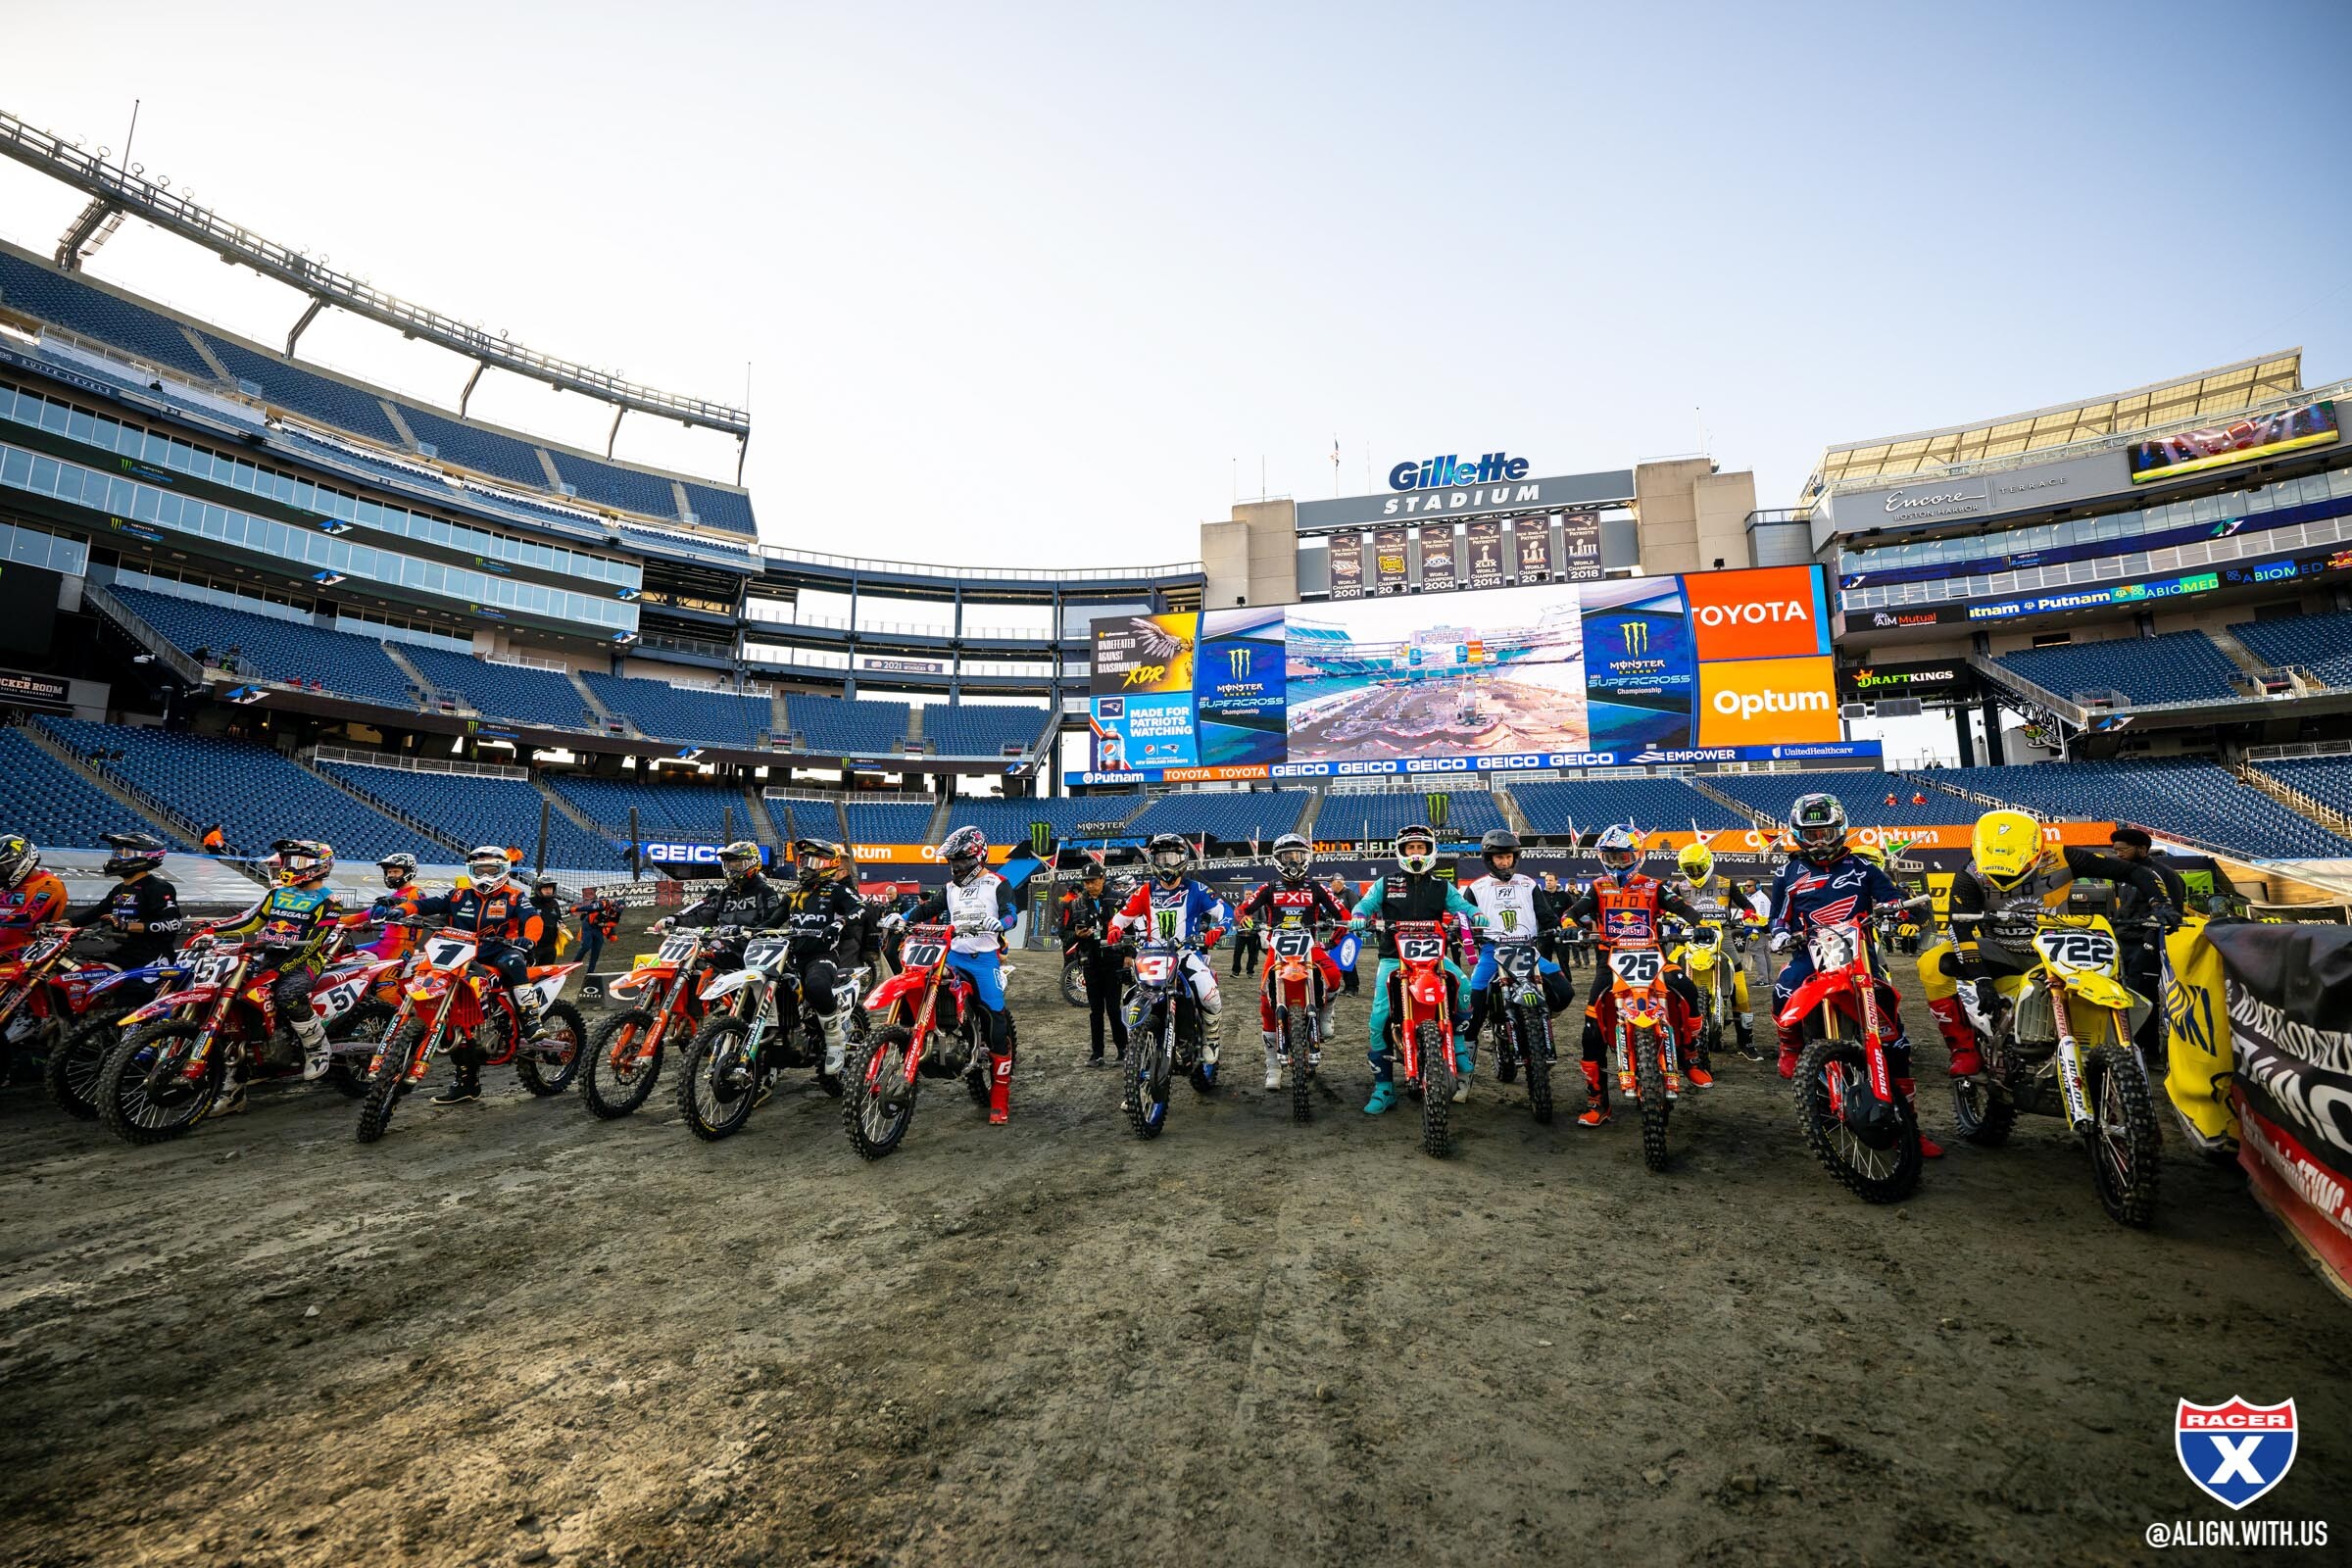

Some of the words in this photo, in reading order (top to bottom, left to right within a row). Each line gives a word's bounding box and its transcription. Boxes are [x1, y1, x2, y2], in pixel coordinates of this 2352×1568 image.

[22, 360, 59, 376] SUITE
[66, 374, 111, 395] LEVELS
[1388, 452, 1530, 491] Gillette
[1383, 485, 1540, 514] STADIUM
[1885, 490, 1986, 513] Encore
[1999, 477, 2067, 494] TERRACE
[1894, 511, 1935, 521] BOSTON
[1936, 504, 1979, 515] HARBOR
[1570, 570, 1599, 579] 2018
[1425, 581, 1454, 590] 2004
[1473, 578, 1500, 587] 2014
[2145, 578, 2220, 599] ABIOMED
[1334, 589, 1360, 598] 2001
[2037, 592, 2111, 611] Putnam
[1690, 601, 1808, 626] TOYOTA
[1876, 616, 1897, 626] AIM
[1898, 612, 1936, 624] Mutual
[1098, 638, 1136, 651] UNDEFEATED
[1098, 651, 1124, 662] AGAINST
[1098, 662, 1142, 674] RANSOMWARE
[1609, 660, 1666, 670] MONSTER
[1121, 665, 1166, 691] XDR
[1588, 674, 1691, 688] SUPERCROSS
[1858, 670, 1954, 688] DRAFTKINGS
[32, 682, 64, 694] ROOM
[1216, 683, 1264, 693] MONSTER
[1617, 686, 1662, 695] Championship
[1199, 697, 1285, 709] SUPERCROSS
[1713, 689, 1830, 720] Optum
[1130, 709, 1163, 718] MADE
[1166, 707, 1190, 716] FOR
[1130, 716, 1187, 728] PATRIOTS
[1130, 725, 1194, 738] WATCHING
[1666, 749, 1736, 761] EMPOWER
[1785, 747, 1854, 757] UnitedHealthcare
[1406, 758, 1467, 771] GEICO
[1476, 756, 1540, 769] GEICO
[1549, 753, 1614, 766] GEICO
[1165, 768, 1210, 781] TOYOTA
[1219, 765, 1266, 778] TOYOTA
[1272, 763, 1329, 777] GEICO
[1338, 760, 1397, 774] GEICO
[1094, 771, 1145, 783] Putnam
[1077, 821, 1126, 832] MONSTER
[1274, 892, 1313, 904] FXR
[1498, 887, 1512, 898] FLY
[270, 908, 313, 920] GASGAS
[660, 943, 695, 960] 711
[1276, 935, 1310, 956] 61
[1404, 940, 1441, 958] 62
[2042, 936, 2115, 965] 722
[433, 944, 466, 966] 1
[746, 944, 785, 966] 27
[906, 945, 942, 966] 10
[1499, 947, 1533, 972] 73
[1139, 956, 1174, 981] 3
[1618, 954, 1659, 981] 25
[327, 983, 359, 1012] 51
[906, 1038, 918, 1072] DUNLOP
[1874, 1049, 1887, 1096] DUNLOP
